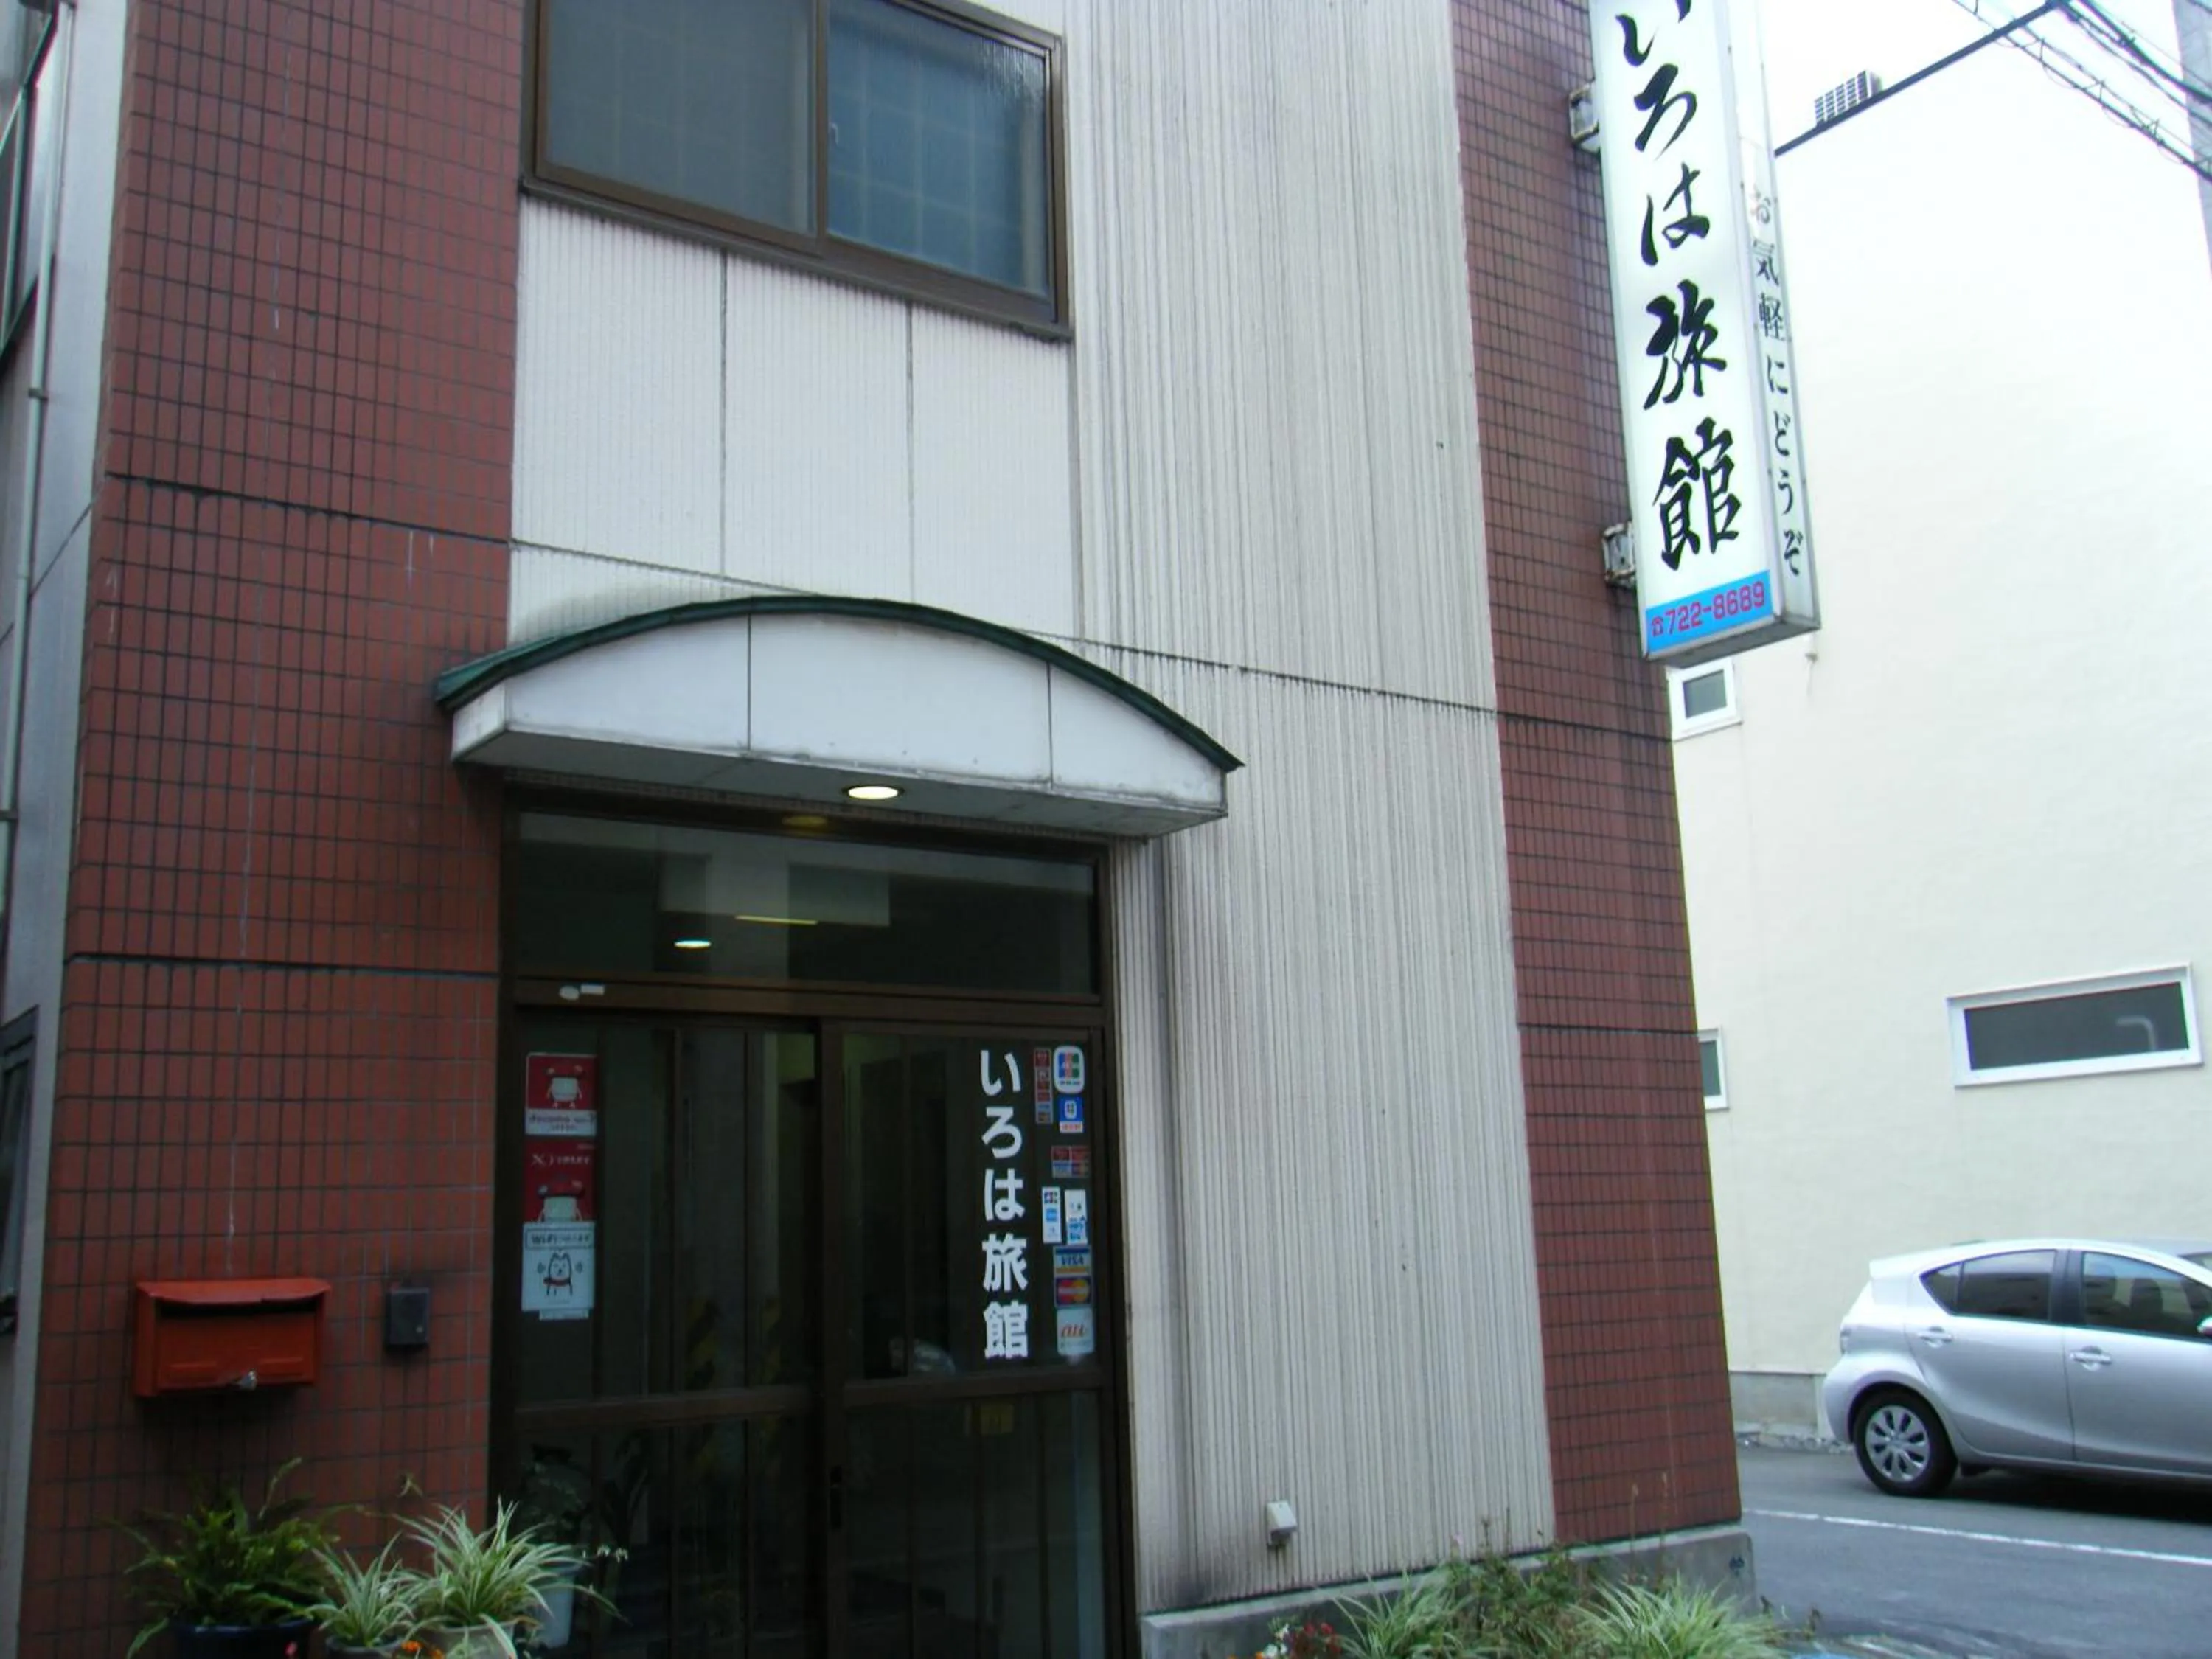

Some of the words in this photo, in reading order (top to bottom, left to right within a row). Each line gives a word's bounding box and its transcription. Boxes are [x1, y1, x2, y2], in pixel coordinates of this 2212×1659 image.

[1665, 581, 1764, 635] 722-8689
[979, 1048, 1029, 1360] いろは旅館
